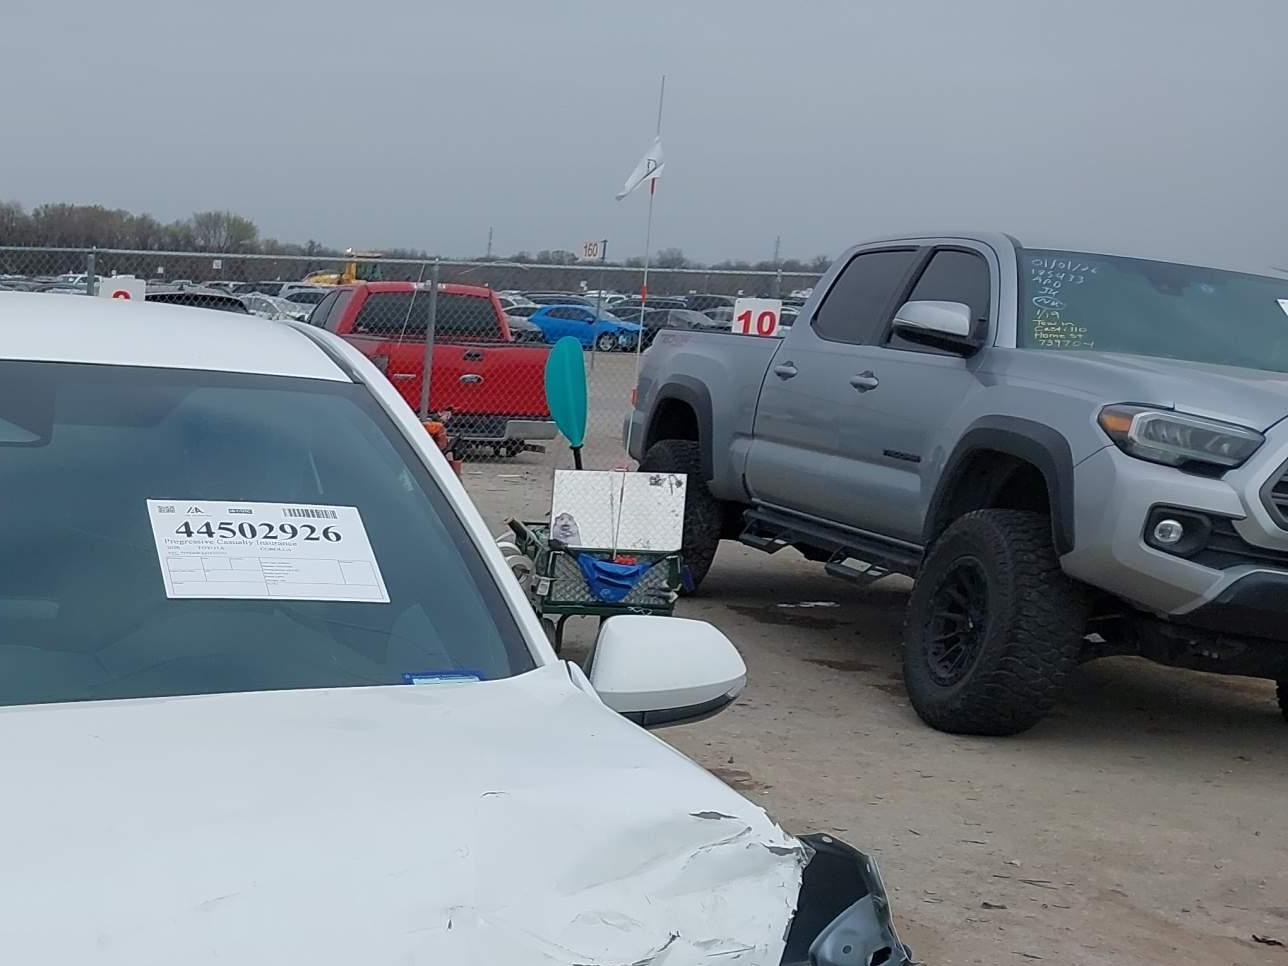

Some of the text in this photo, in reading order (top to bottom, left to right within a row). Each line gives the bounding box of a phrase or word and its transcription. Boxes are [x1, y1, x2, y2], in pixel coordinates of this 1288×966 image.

[583, 243, 599, 257] 160
[737, 309, 777, 337] 10
[175, 520, 343, 543] 44502926
[164, 538, 213, 547] Progressive
[216, 539, 253, 547] Casualty
